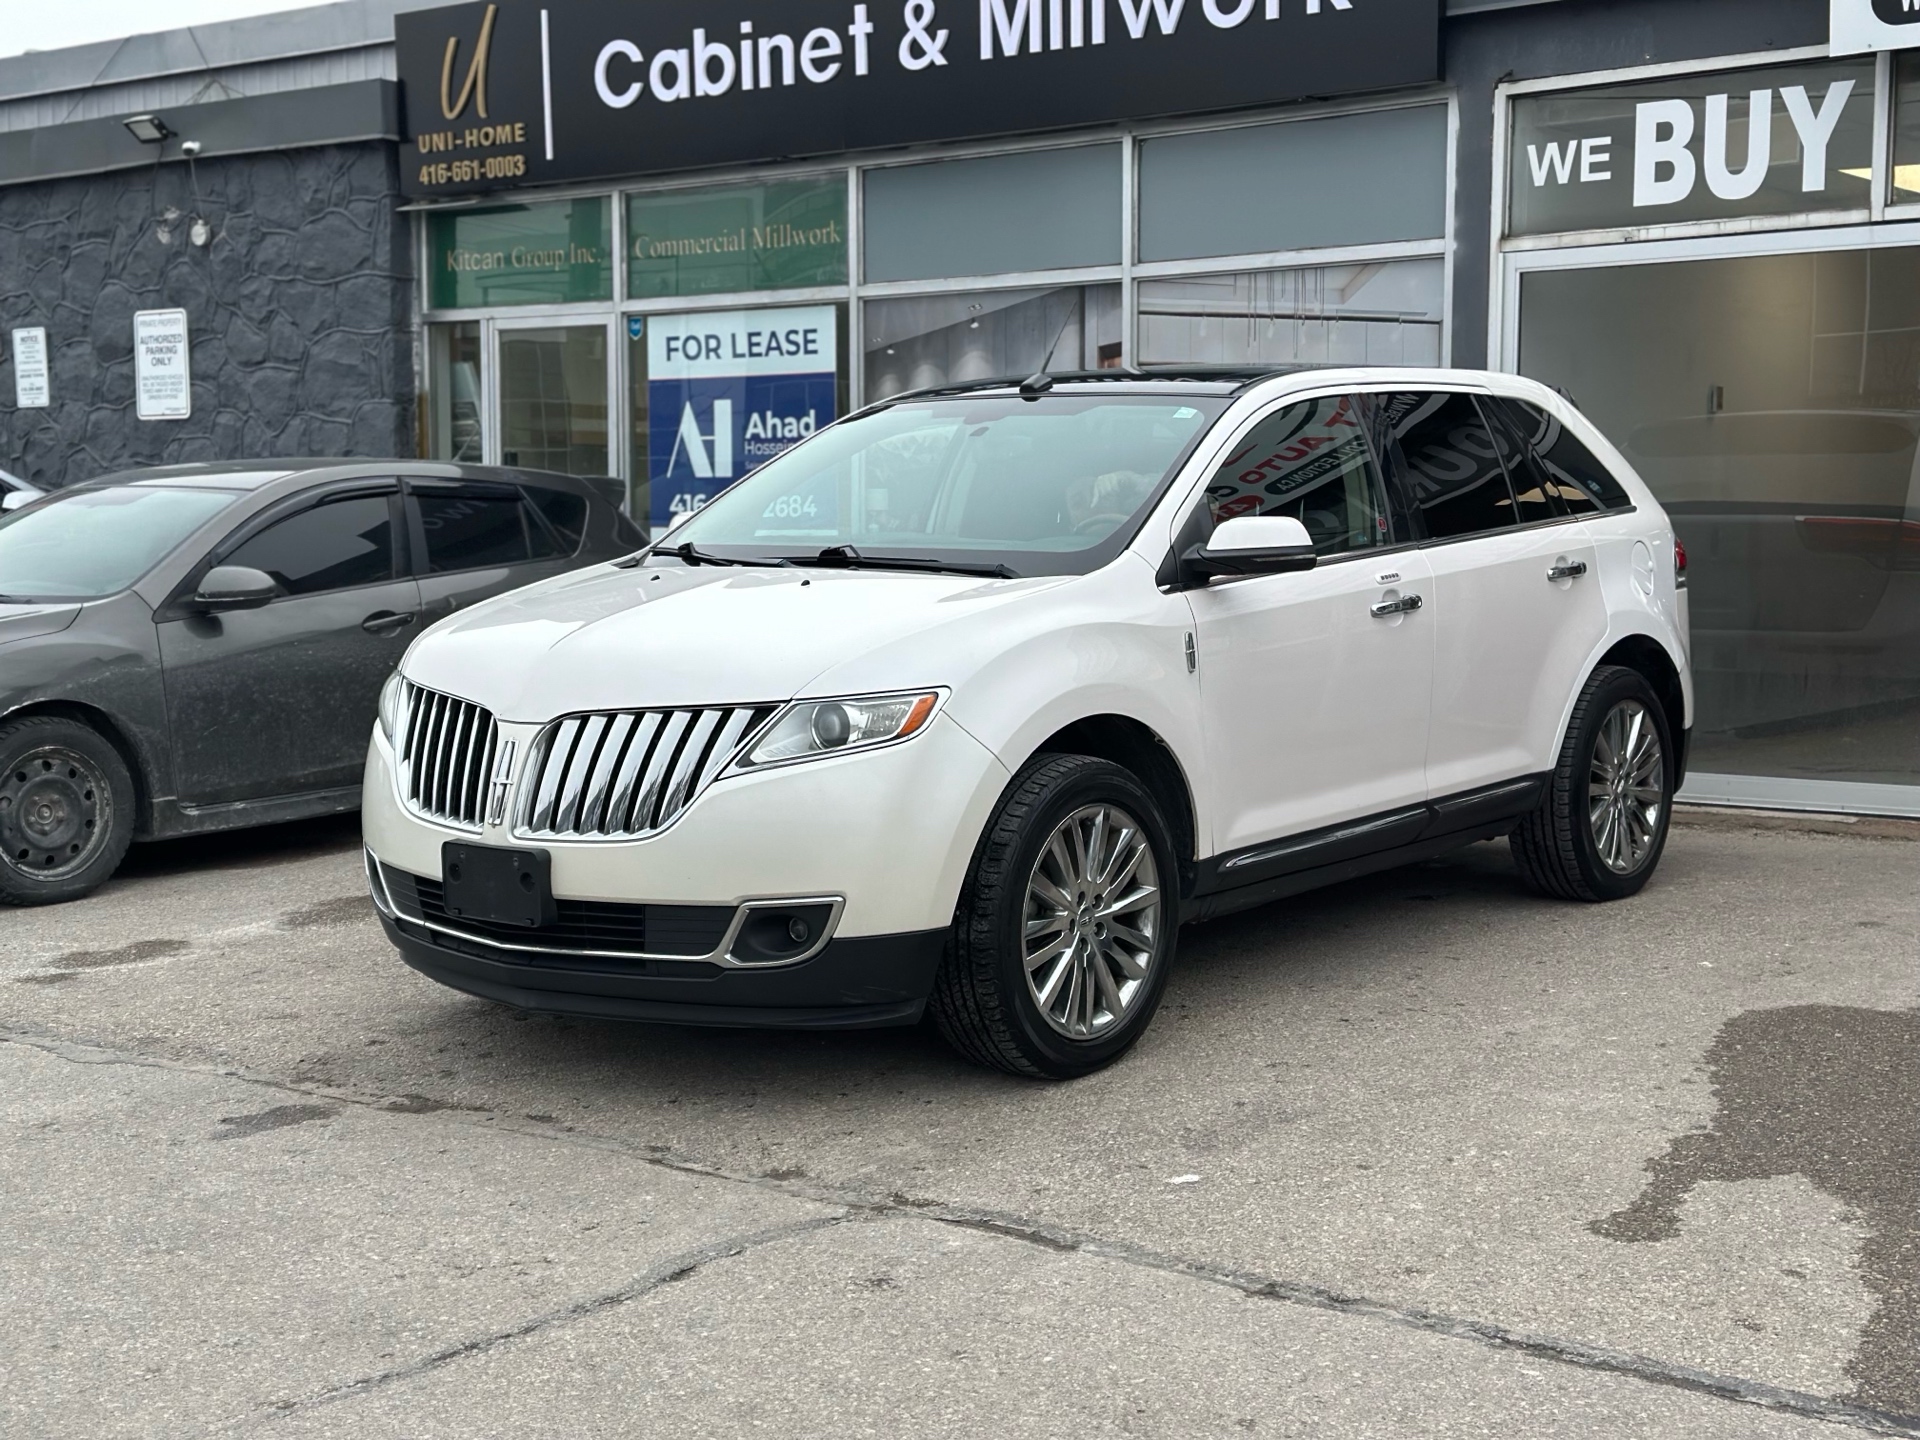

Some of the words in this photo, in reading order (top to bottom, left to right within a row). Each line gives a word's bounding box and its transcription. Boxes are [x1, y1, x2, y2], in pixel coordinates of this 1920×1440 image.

[594, 4, 874, 109] Cabinet
[898, 0, 949, 71] &
[418, 122, 526, 153] UNI-HOME
[1527, 136, 1612, 187] WE
[1633, 80, 1856, 207] BUY
[419, 154, 526, 185] 416-661-0003
[634, 227, 746, 259] Commercial
[753, 220, 841, 249] Millwork
[447, 249, 505, 271] Kitcan
[511, 245, 565, 271] Group
[570, 242, 602, 264] Inc.
[140, 333, 182, 345] AUTHORIZED
[145, 345, 177, 356] PARKING
[665, 333, 722, 362] FOR
[731, 328, 819, 359] LEASE
[151, 356, 172, 367] ONLY
[744, 409, 816, 440] Ahad
